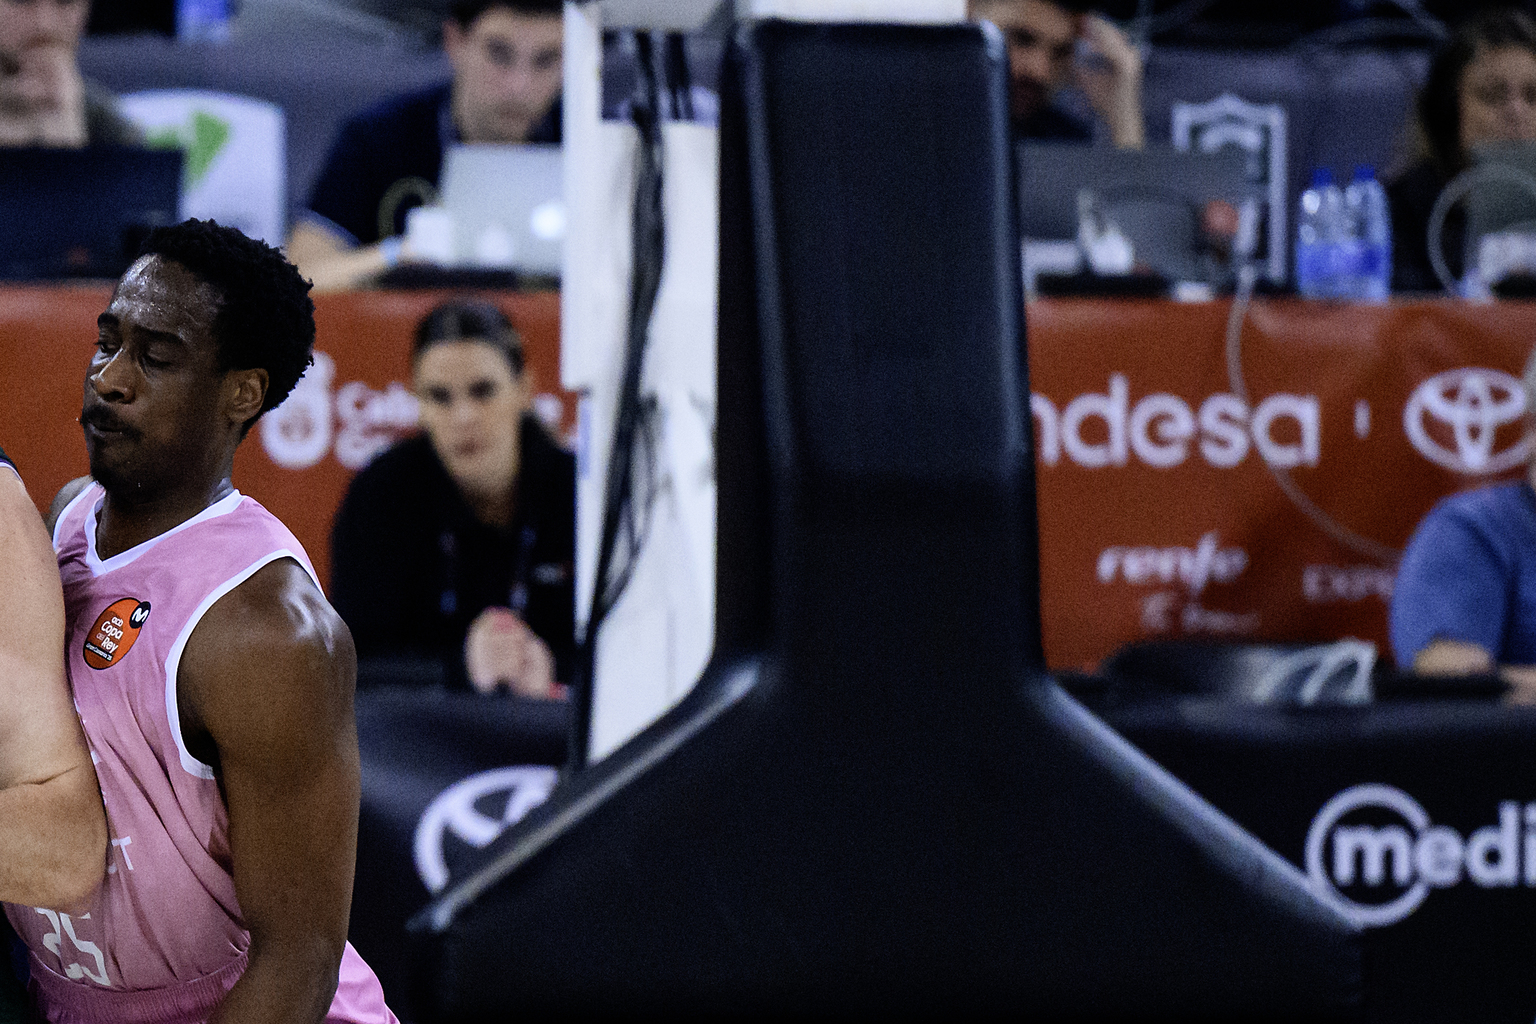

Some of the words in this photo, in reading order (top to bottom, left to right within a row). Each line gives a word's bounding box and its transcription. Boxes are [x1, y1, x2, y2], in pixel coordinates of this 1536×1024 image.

[101, 620, 124, 640] Copa
[111, 616, 124, 628] acb
[101, 636, 119, 653] Rey
